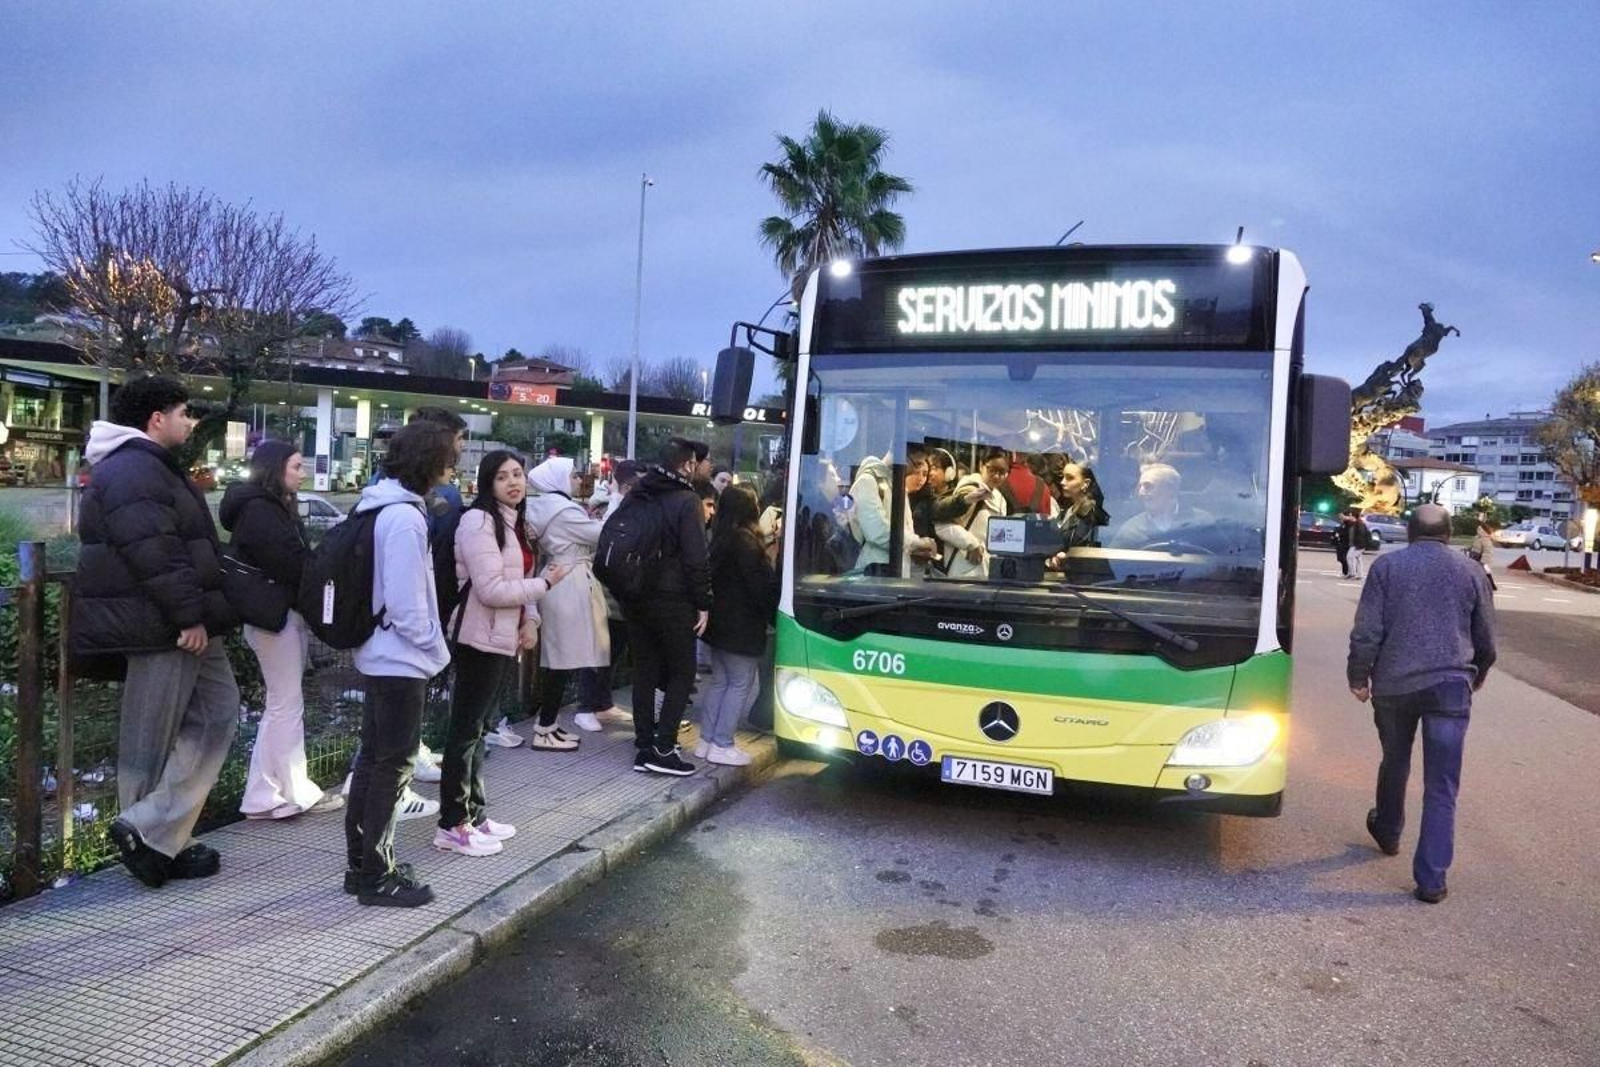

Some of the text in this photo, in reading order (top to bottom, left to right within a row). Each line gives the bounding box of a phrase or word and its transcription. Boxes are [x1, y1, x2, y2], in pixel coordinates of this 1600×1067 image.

[898, 280, 1175, 333] SERVIZOS MINIMOS
[691, 403, 766, 421] ROL
[937, 622, 975, 632] avanza
[852, 649, 906, 675] 6706
[956, 761, 1048, 790] 7159 MGN
